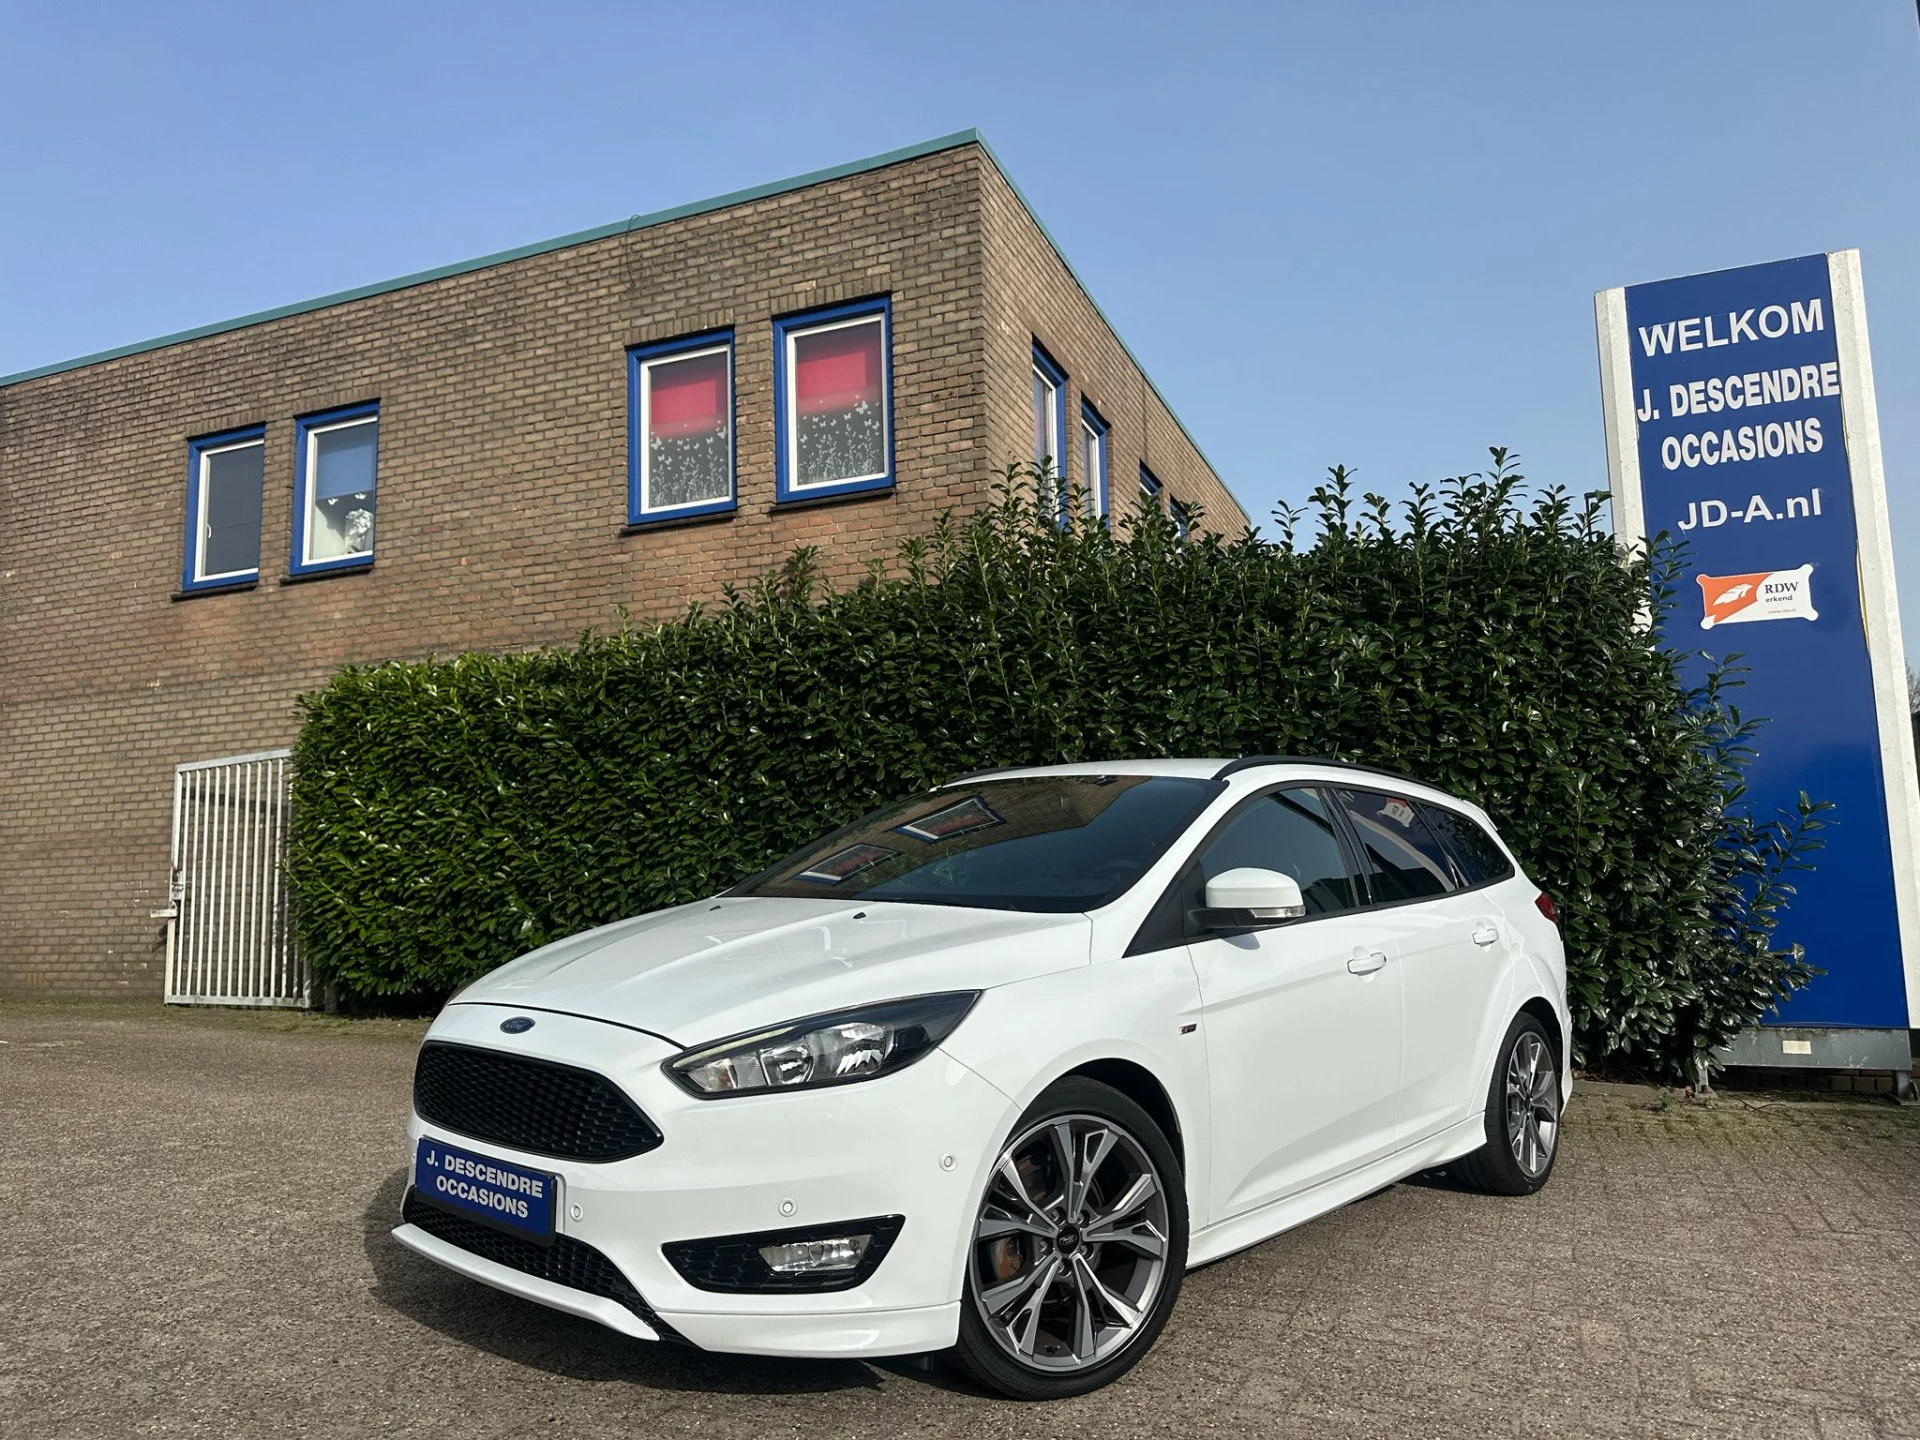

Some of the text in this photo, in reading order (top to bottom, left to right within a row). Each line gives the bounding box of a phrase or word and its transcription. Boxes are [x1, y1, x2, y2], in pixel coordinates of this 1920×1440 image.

[1638, 298, 1825, 358] WELKOM
[1637, 361, 1841, 422] J. DESCENDRE
[1661, 417, 1824, 471] OCCASIONS
[1677, 487, 1822, 531] JD-A.nl
[1764, 581, 1799, 594] RDW
[1765, 594, 1793, 602] erkend
[426, 1150, 543, 1199] J. DESCENDRE
[436, 1175, 529, 1219] OCCASIONS
